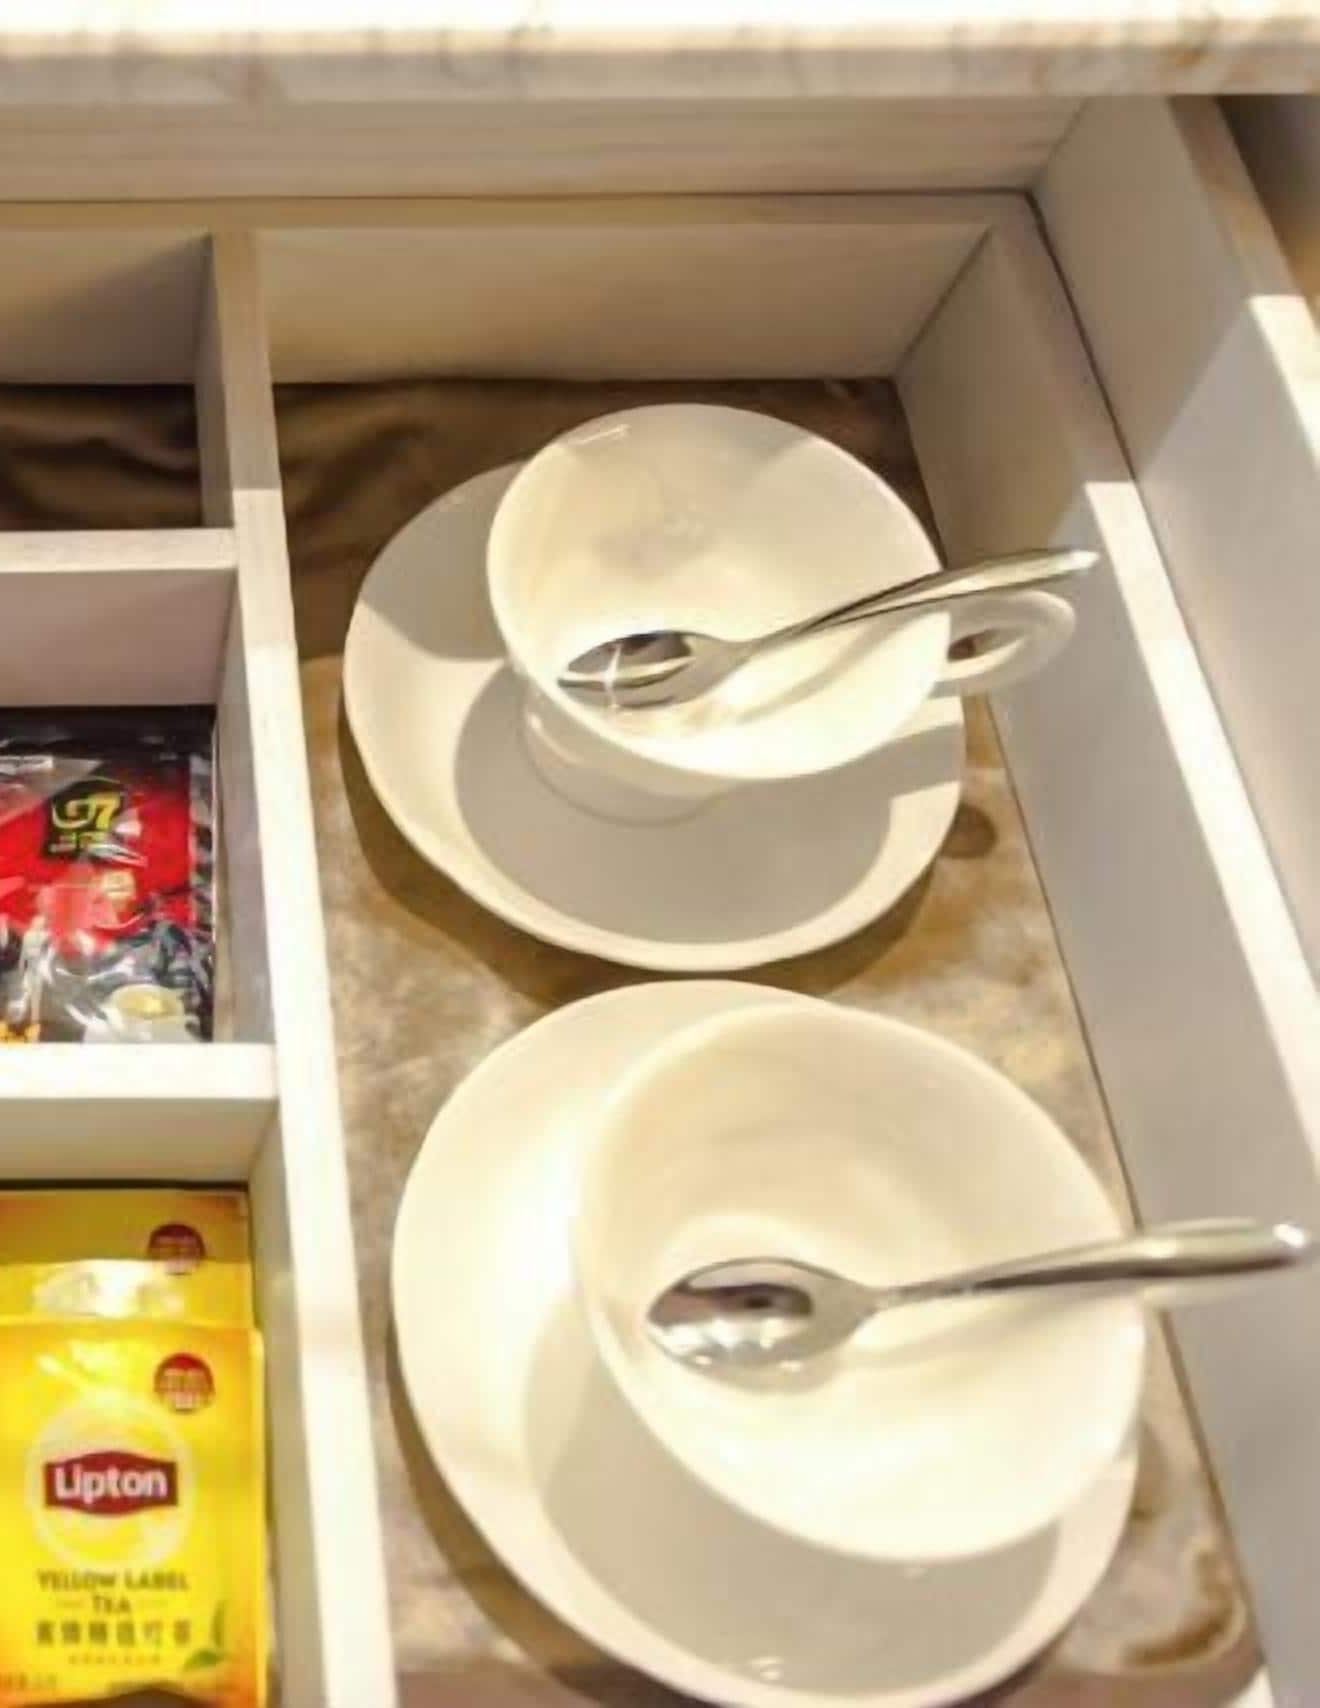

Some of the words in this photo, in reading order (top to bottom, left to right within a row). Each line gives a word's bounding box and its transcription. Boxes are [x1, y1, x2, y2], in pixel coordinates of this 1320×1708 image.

[54, 1463, 168, 1504] Lipton
[37, 1570, 116, 1591] YELLOW
[124, 1572, 189, 1590] LABEL
[91, 1595, 132, 1614] TEA
